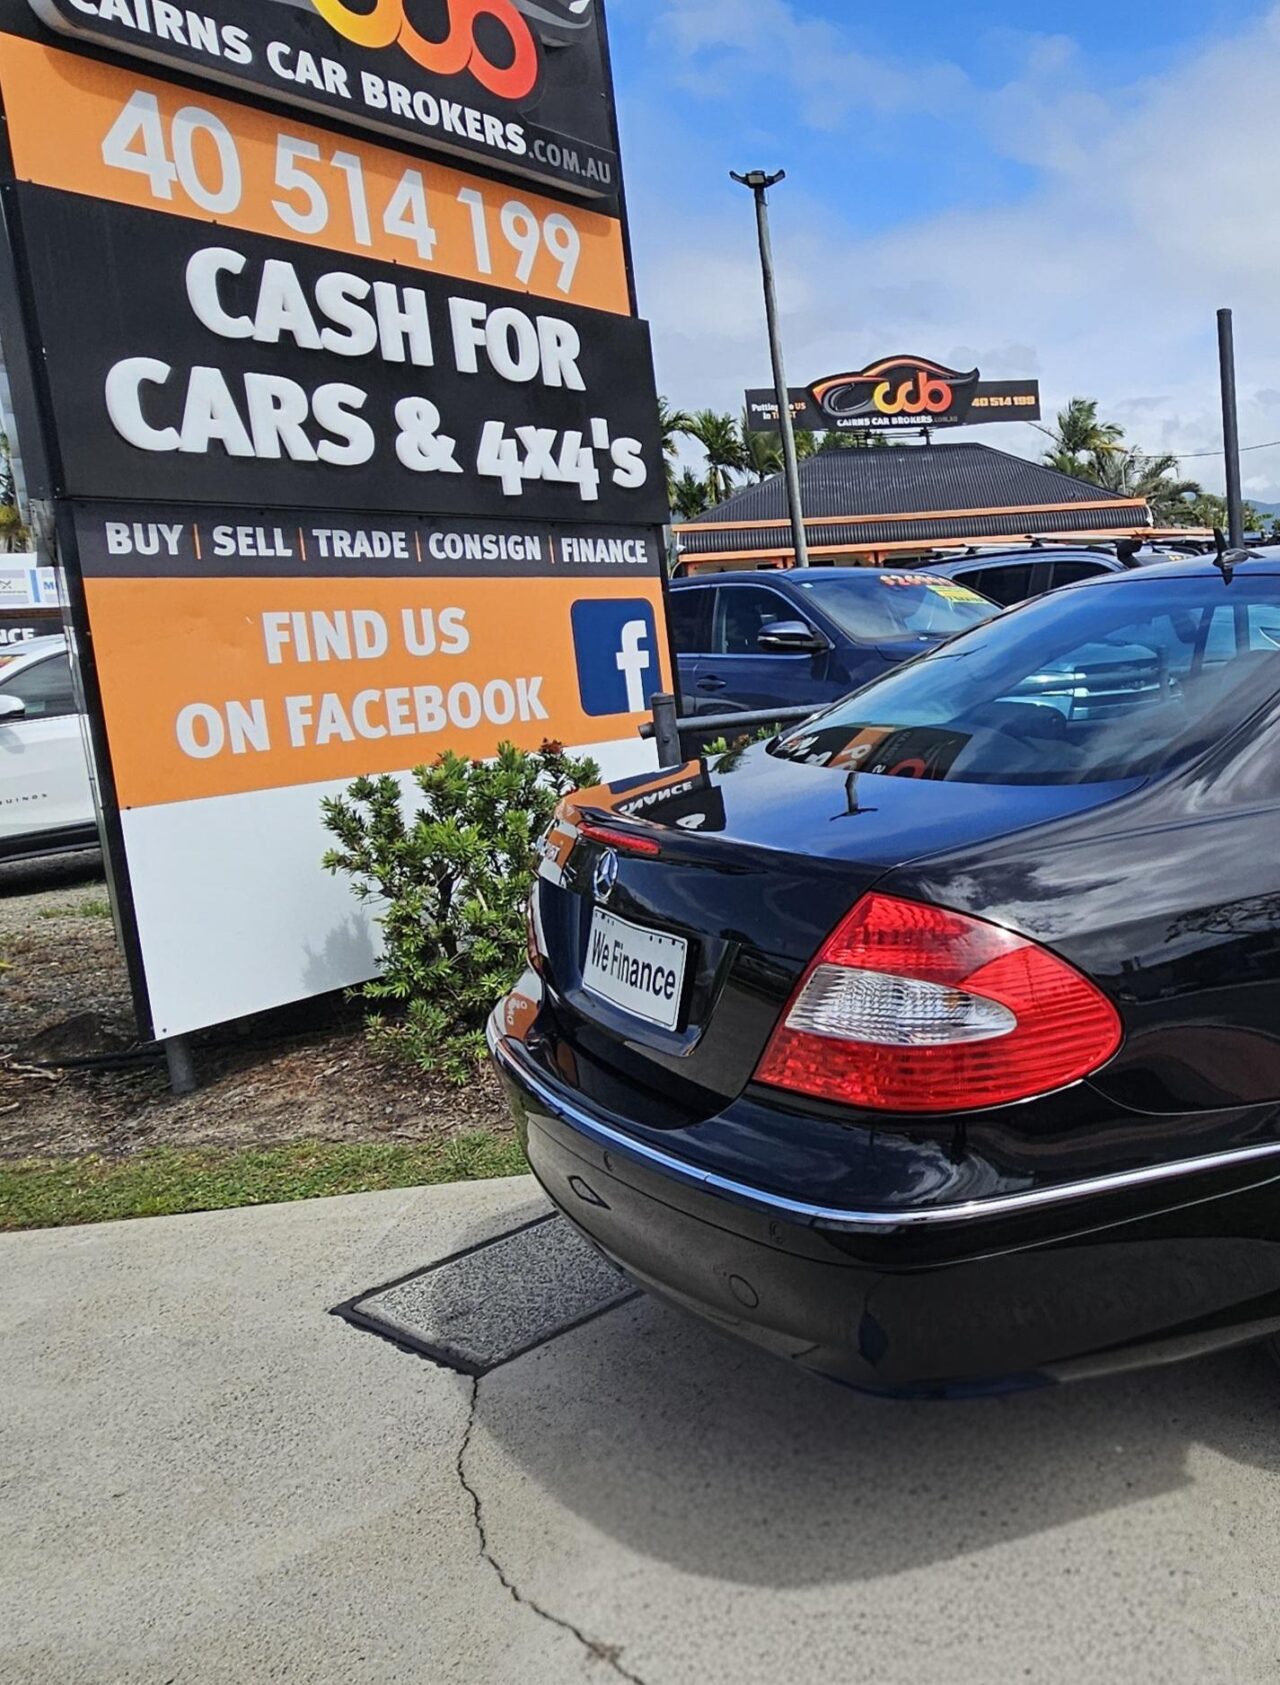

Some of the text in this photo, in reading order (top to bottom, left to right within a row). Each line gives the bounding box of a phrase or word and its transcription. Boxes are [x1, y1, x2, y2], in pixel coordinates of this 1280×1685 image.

[267, 41, 351, 98] CAR
[101, 90, 580, 294] 40 514 199
[185, 247, 586, 391] CASH FOR
[105, 357, 375, 466] CARS
[395, 396, 464, 473] &
[837, 418, 870, 427] CAIRNS
[871, 417, 889, 425] CAR
[971, 397, 988, 407] 40
[990, 396, 1012, 406] 514
[105, 522, 648, 564] BUY SELL TRADE CONSIGN FINANCE
[262, 607, 470, 664] FIND US
[176, 676, 549, 758] ON FACEBOOK
[591, 928, 677, 1000] We Finance
